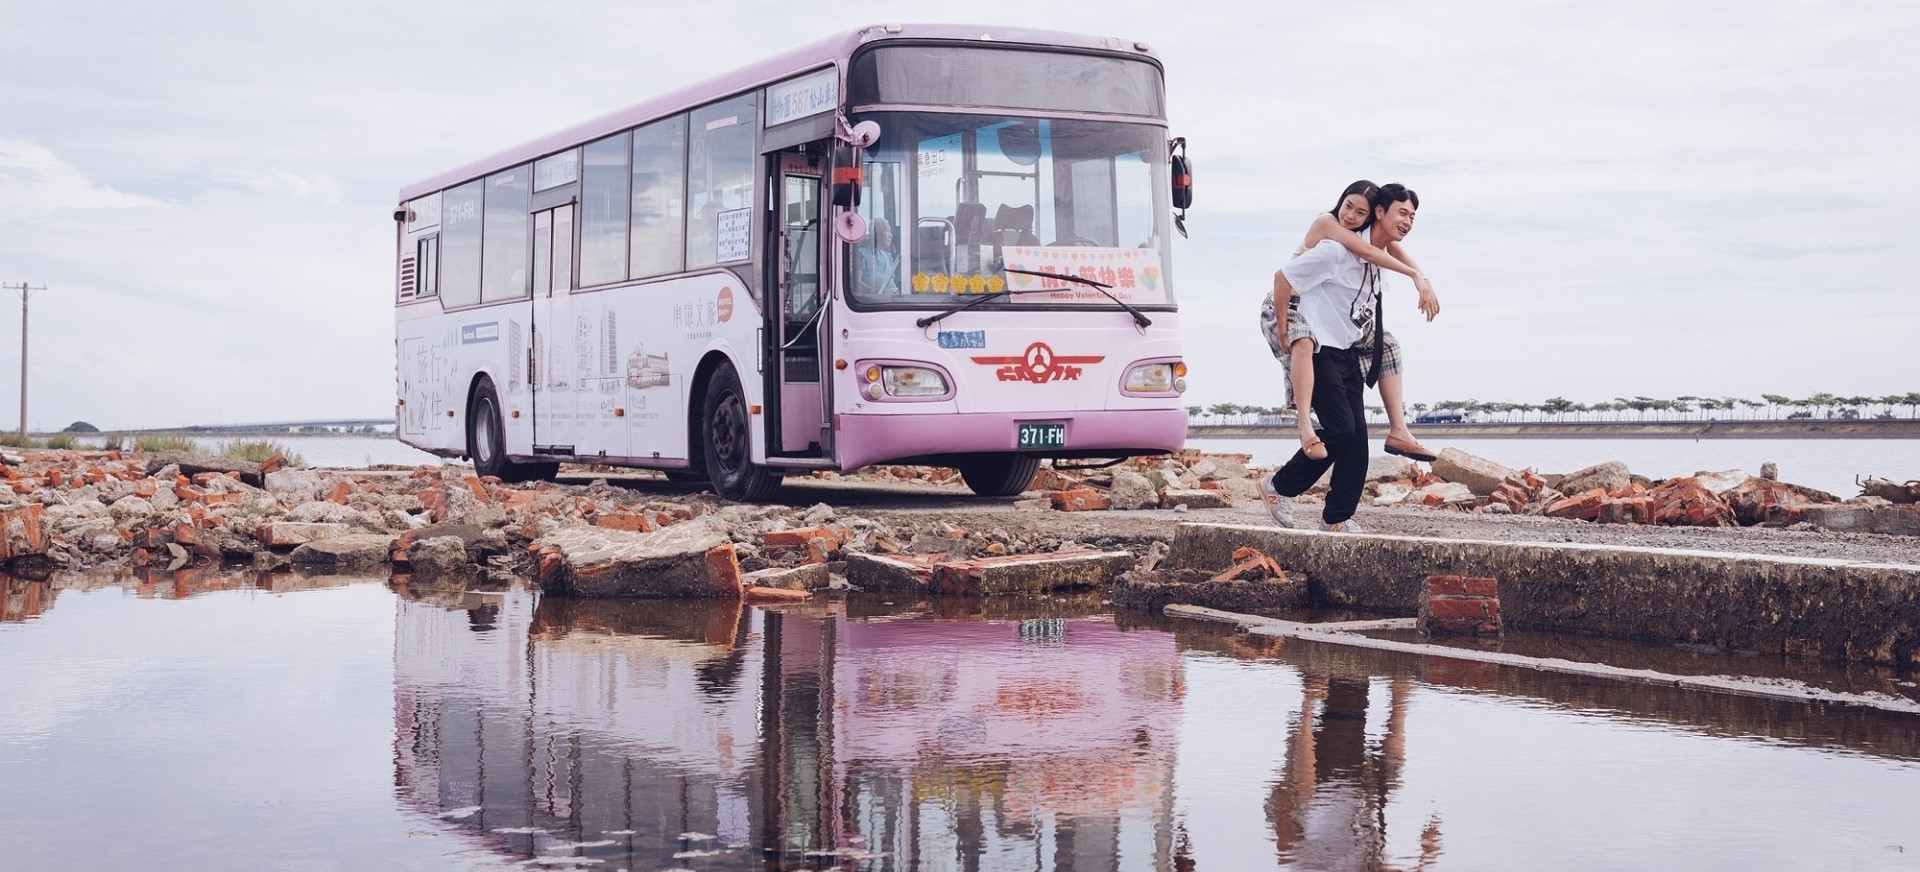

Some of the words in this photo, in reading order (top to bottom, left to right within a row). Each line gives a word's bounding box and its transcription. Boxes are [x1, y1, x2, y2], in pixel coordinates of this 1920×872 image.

[792, 89, 808, 115] 587
[449, 201, 474, 224] 371-FH
[1039, 265, 1136, 289] 情人節快樂
[1050, 292, 1074, 300] Happy
[1118, 292, 1132, 300] Day
